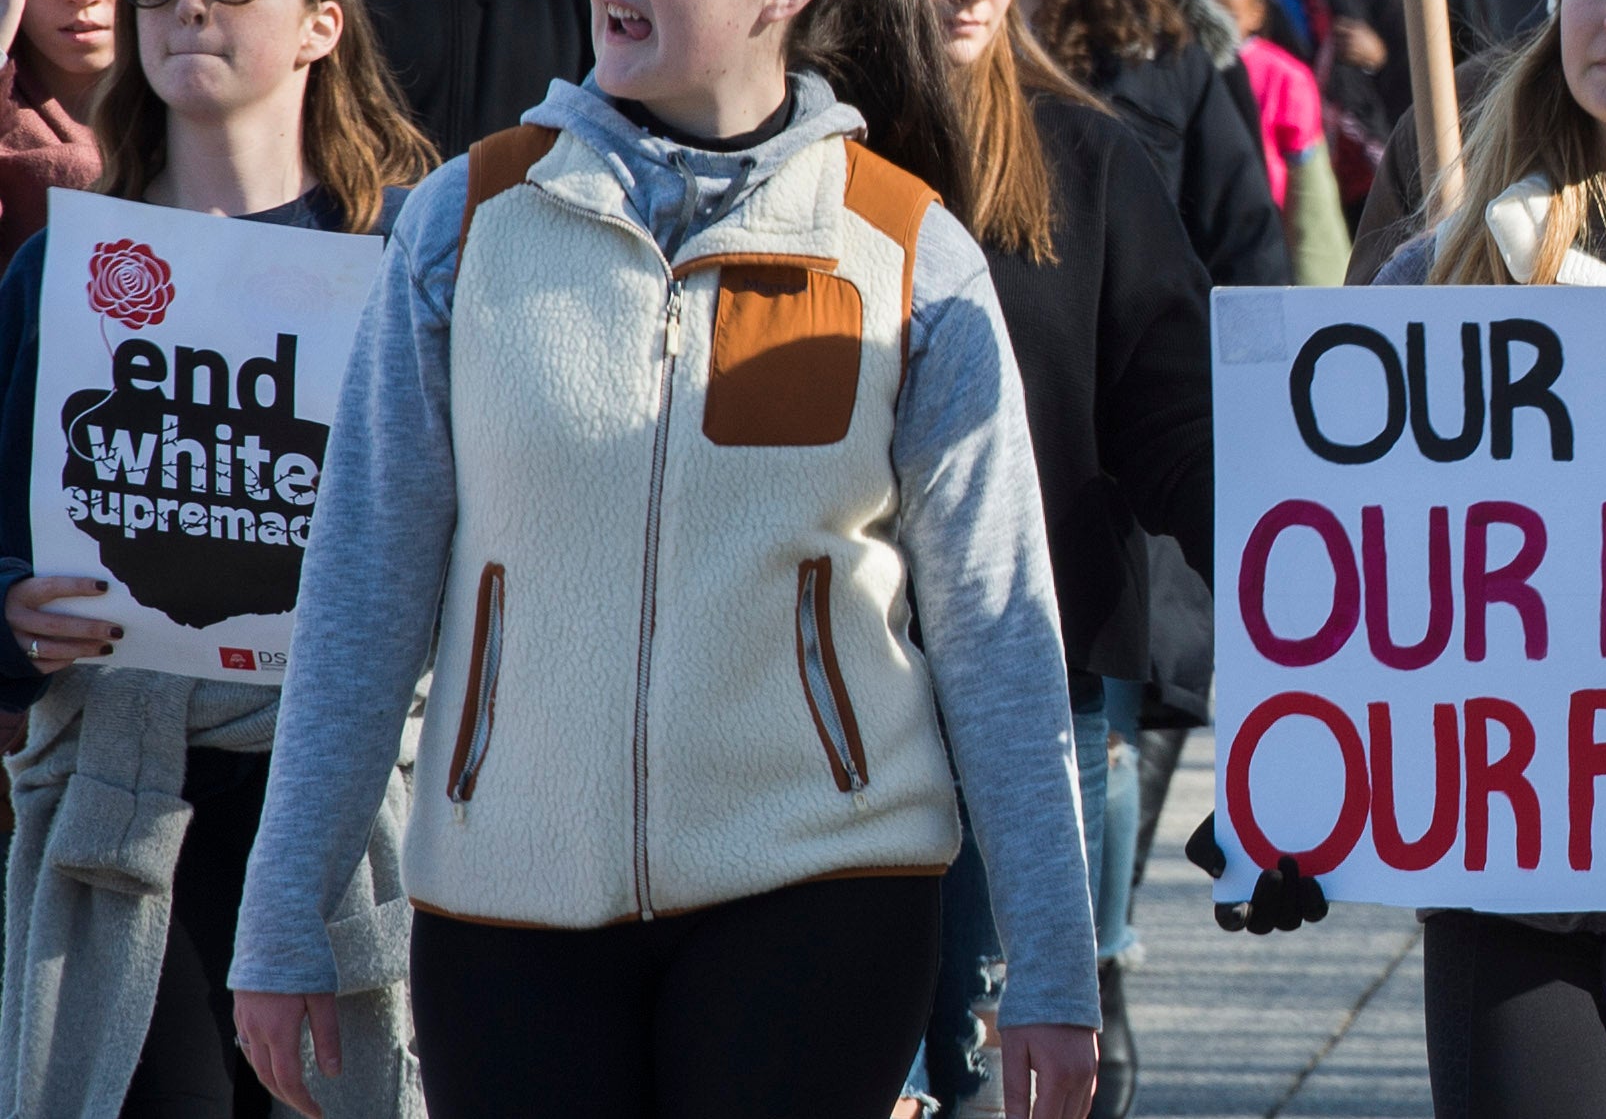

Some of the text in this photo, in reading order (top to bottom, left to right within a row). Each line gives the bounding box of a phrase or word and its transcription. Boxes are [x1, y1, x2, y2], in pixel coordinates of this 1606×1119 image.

[112, 333, 298, 413] end
[1289, 318, 1574, 465] OUR
[87, 414, 319, 506] white
[1238, 499, 1548, 671] OUR
[1226, 691, 1541, 877] OUR
